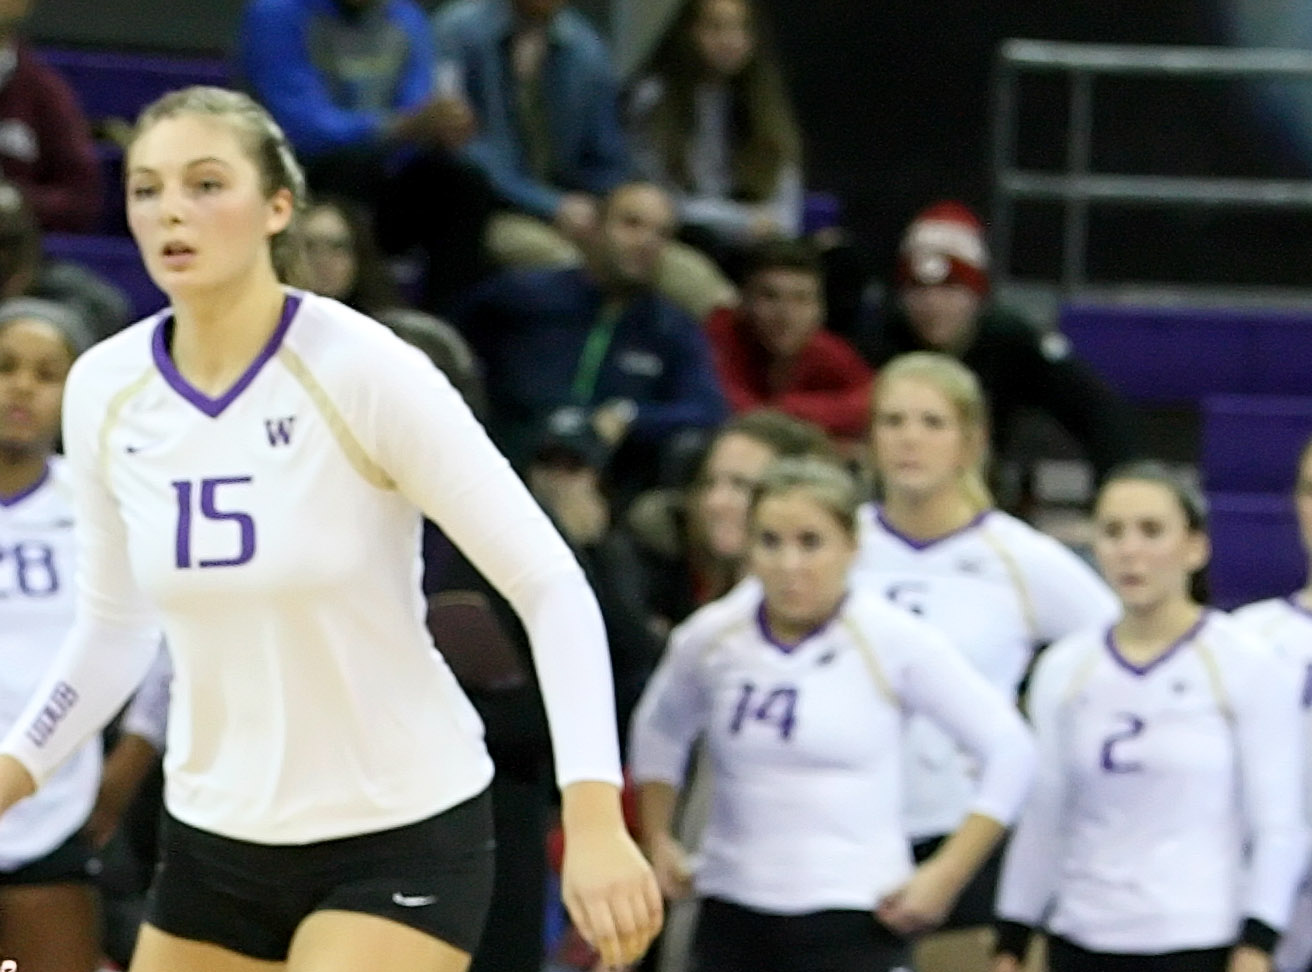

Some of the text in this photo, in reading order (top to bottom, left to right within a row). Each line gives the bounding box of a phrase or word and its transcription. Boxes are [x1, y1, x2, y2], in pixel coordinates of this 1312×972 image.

[265, 416, 296, 447] W
[171, 476, 256, 568] 15
[729, 683, 798, 741] 14
[1102, 711, 1146, 774] 2
